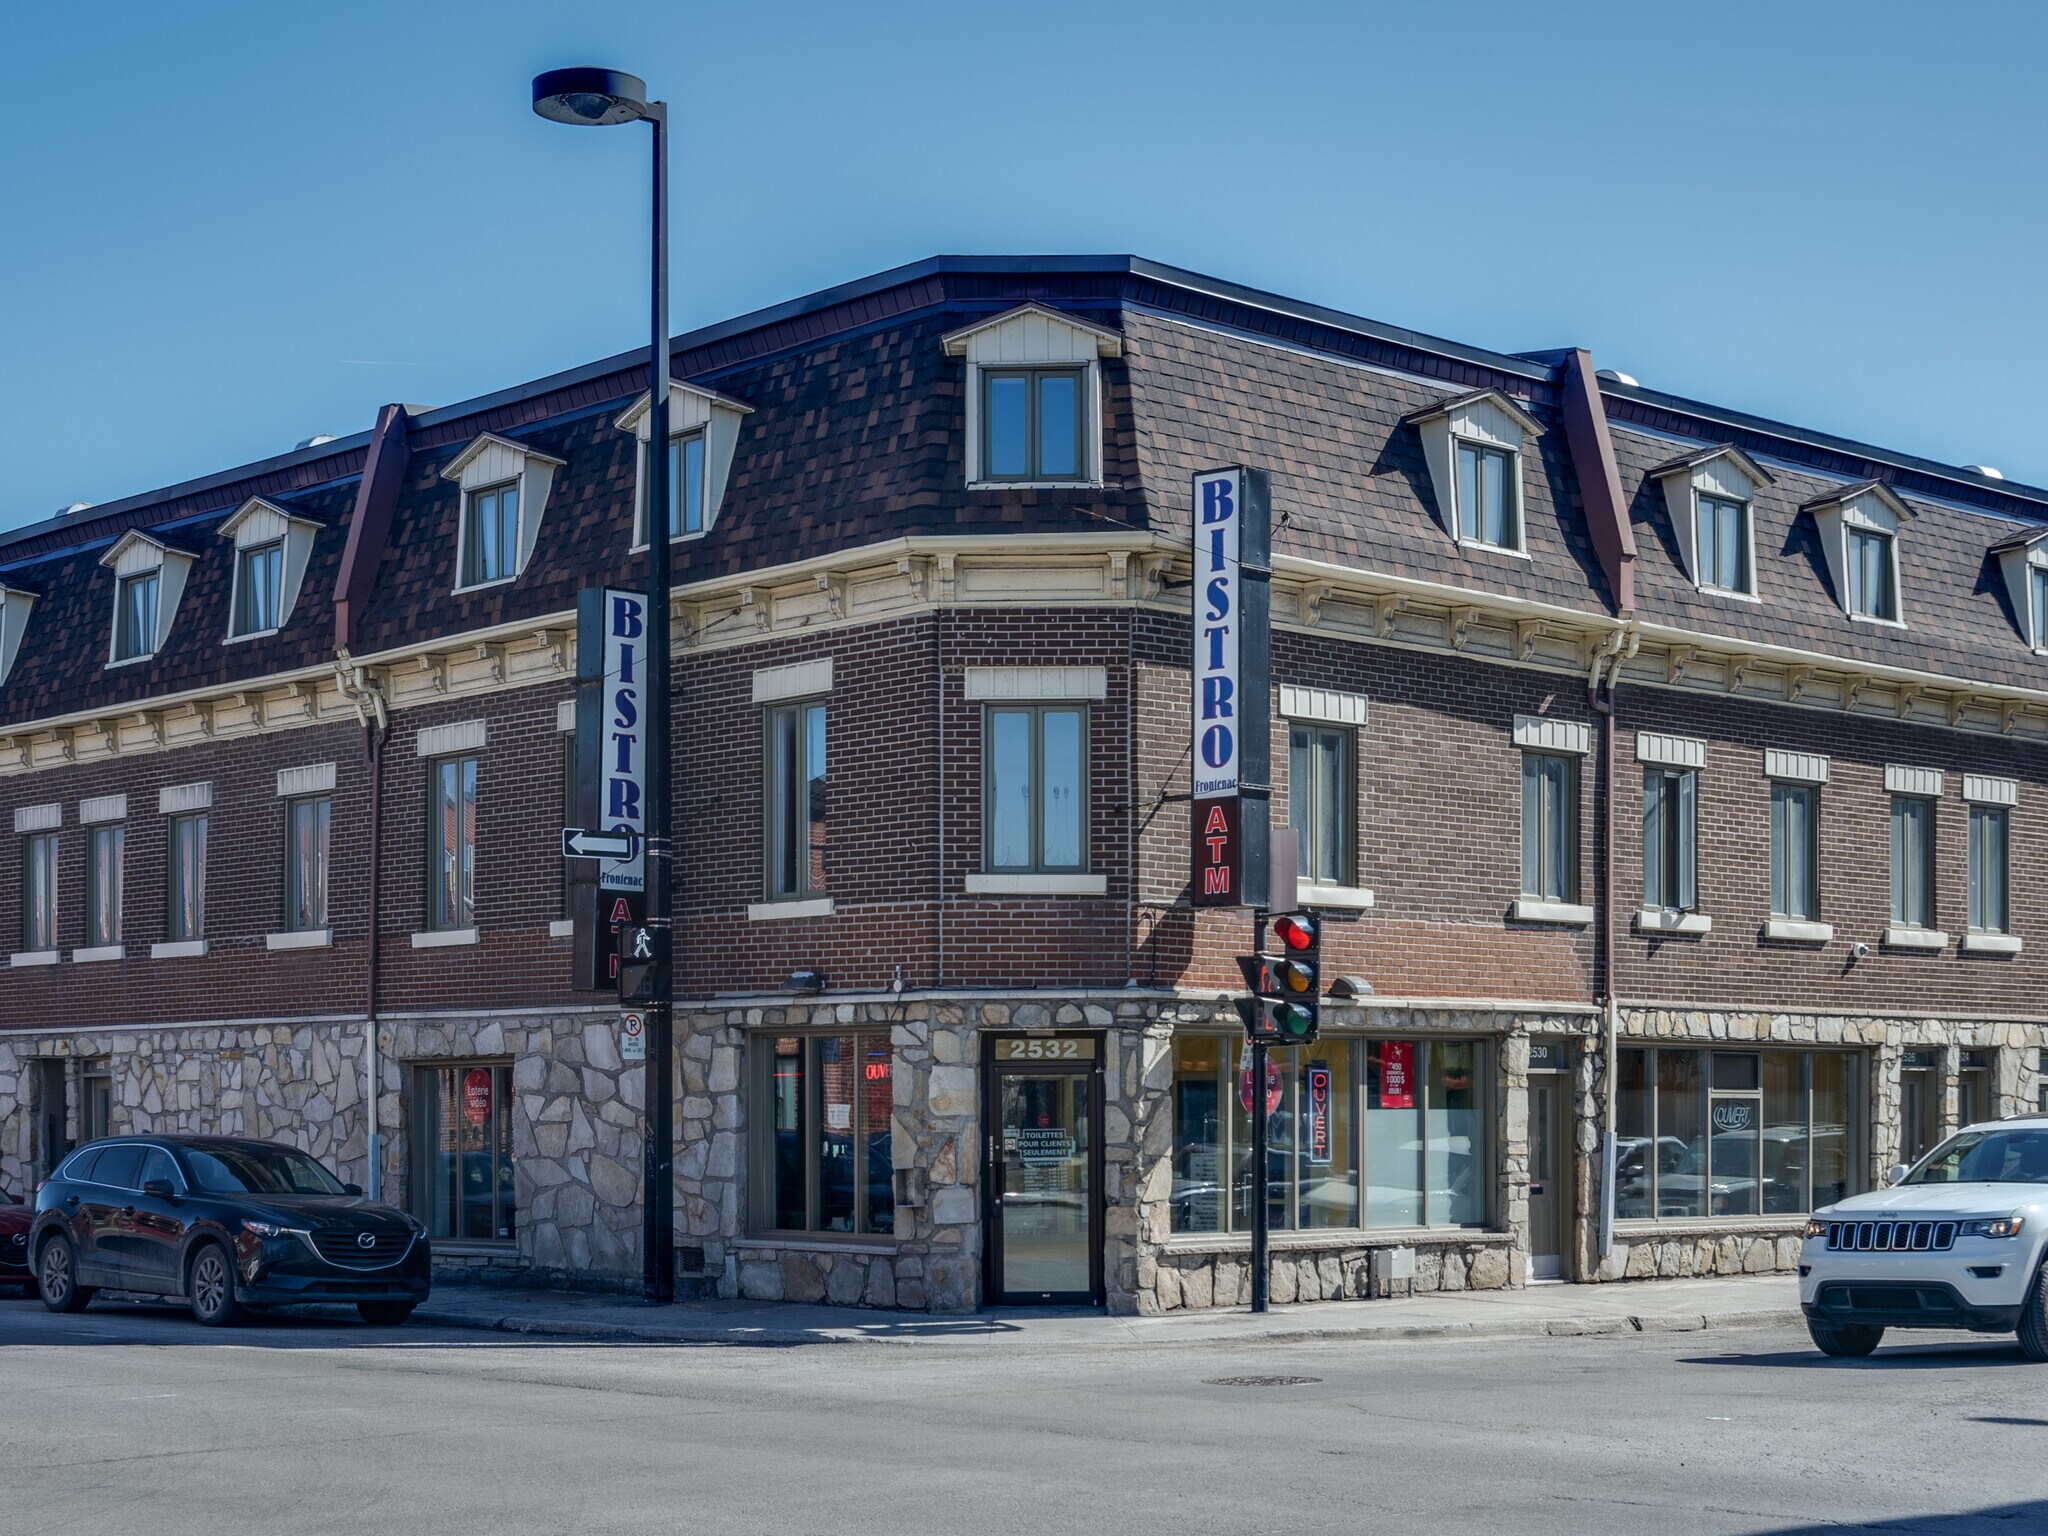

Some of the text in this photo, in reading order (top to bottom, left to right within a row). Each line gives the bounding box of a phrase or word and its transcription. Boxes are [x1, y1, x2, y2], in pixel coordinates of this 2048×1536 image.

[1202, 478, 1234, 769] BISTRO
[1195, 778, 1237, 793] Frontenac
[1205, 805, 1229, 894] ATM
[601, 872, 643, 887] Frontenac
[1010, 1040, 1078, 1058] 2532
[468, 1085, 489, 1096] Loterie
[1313, 1073, 1327, 1158] OUVERT
[1717, 1106, 1750, 1123] OUVERT
